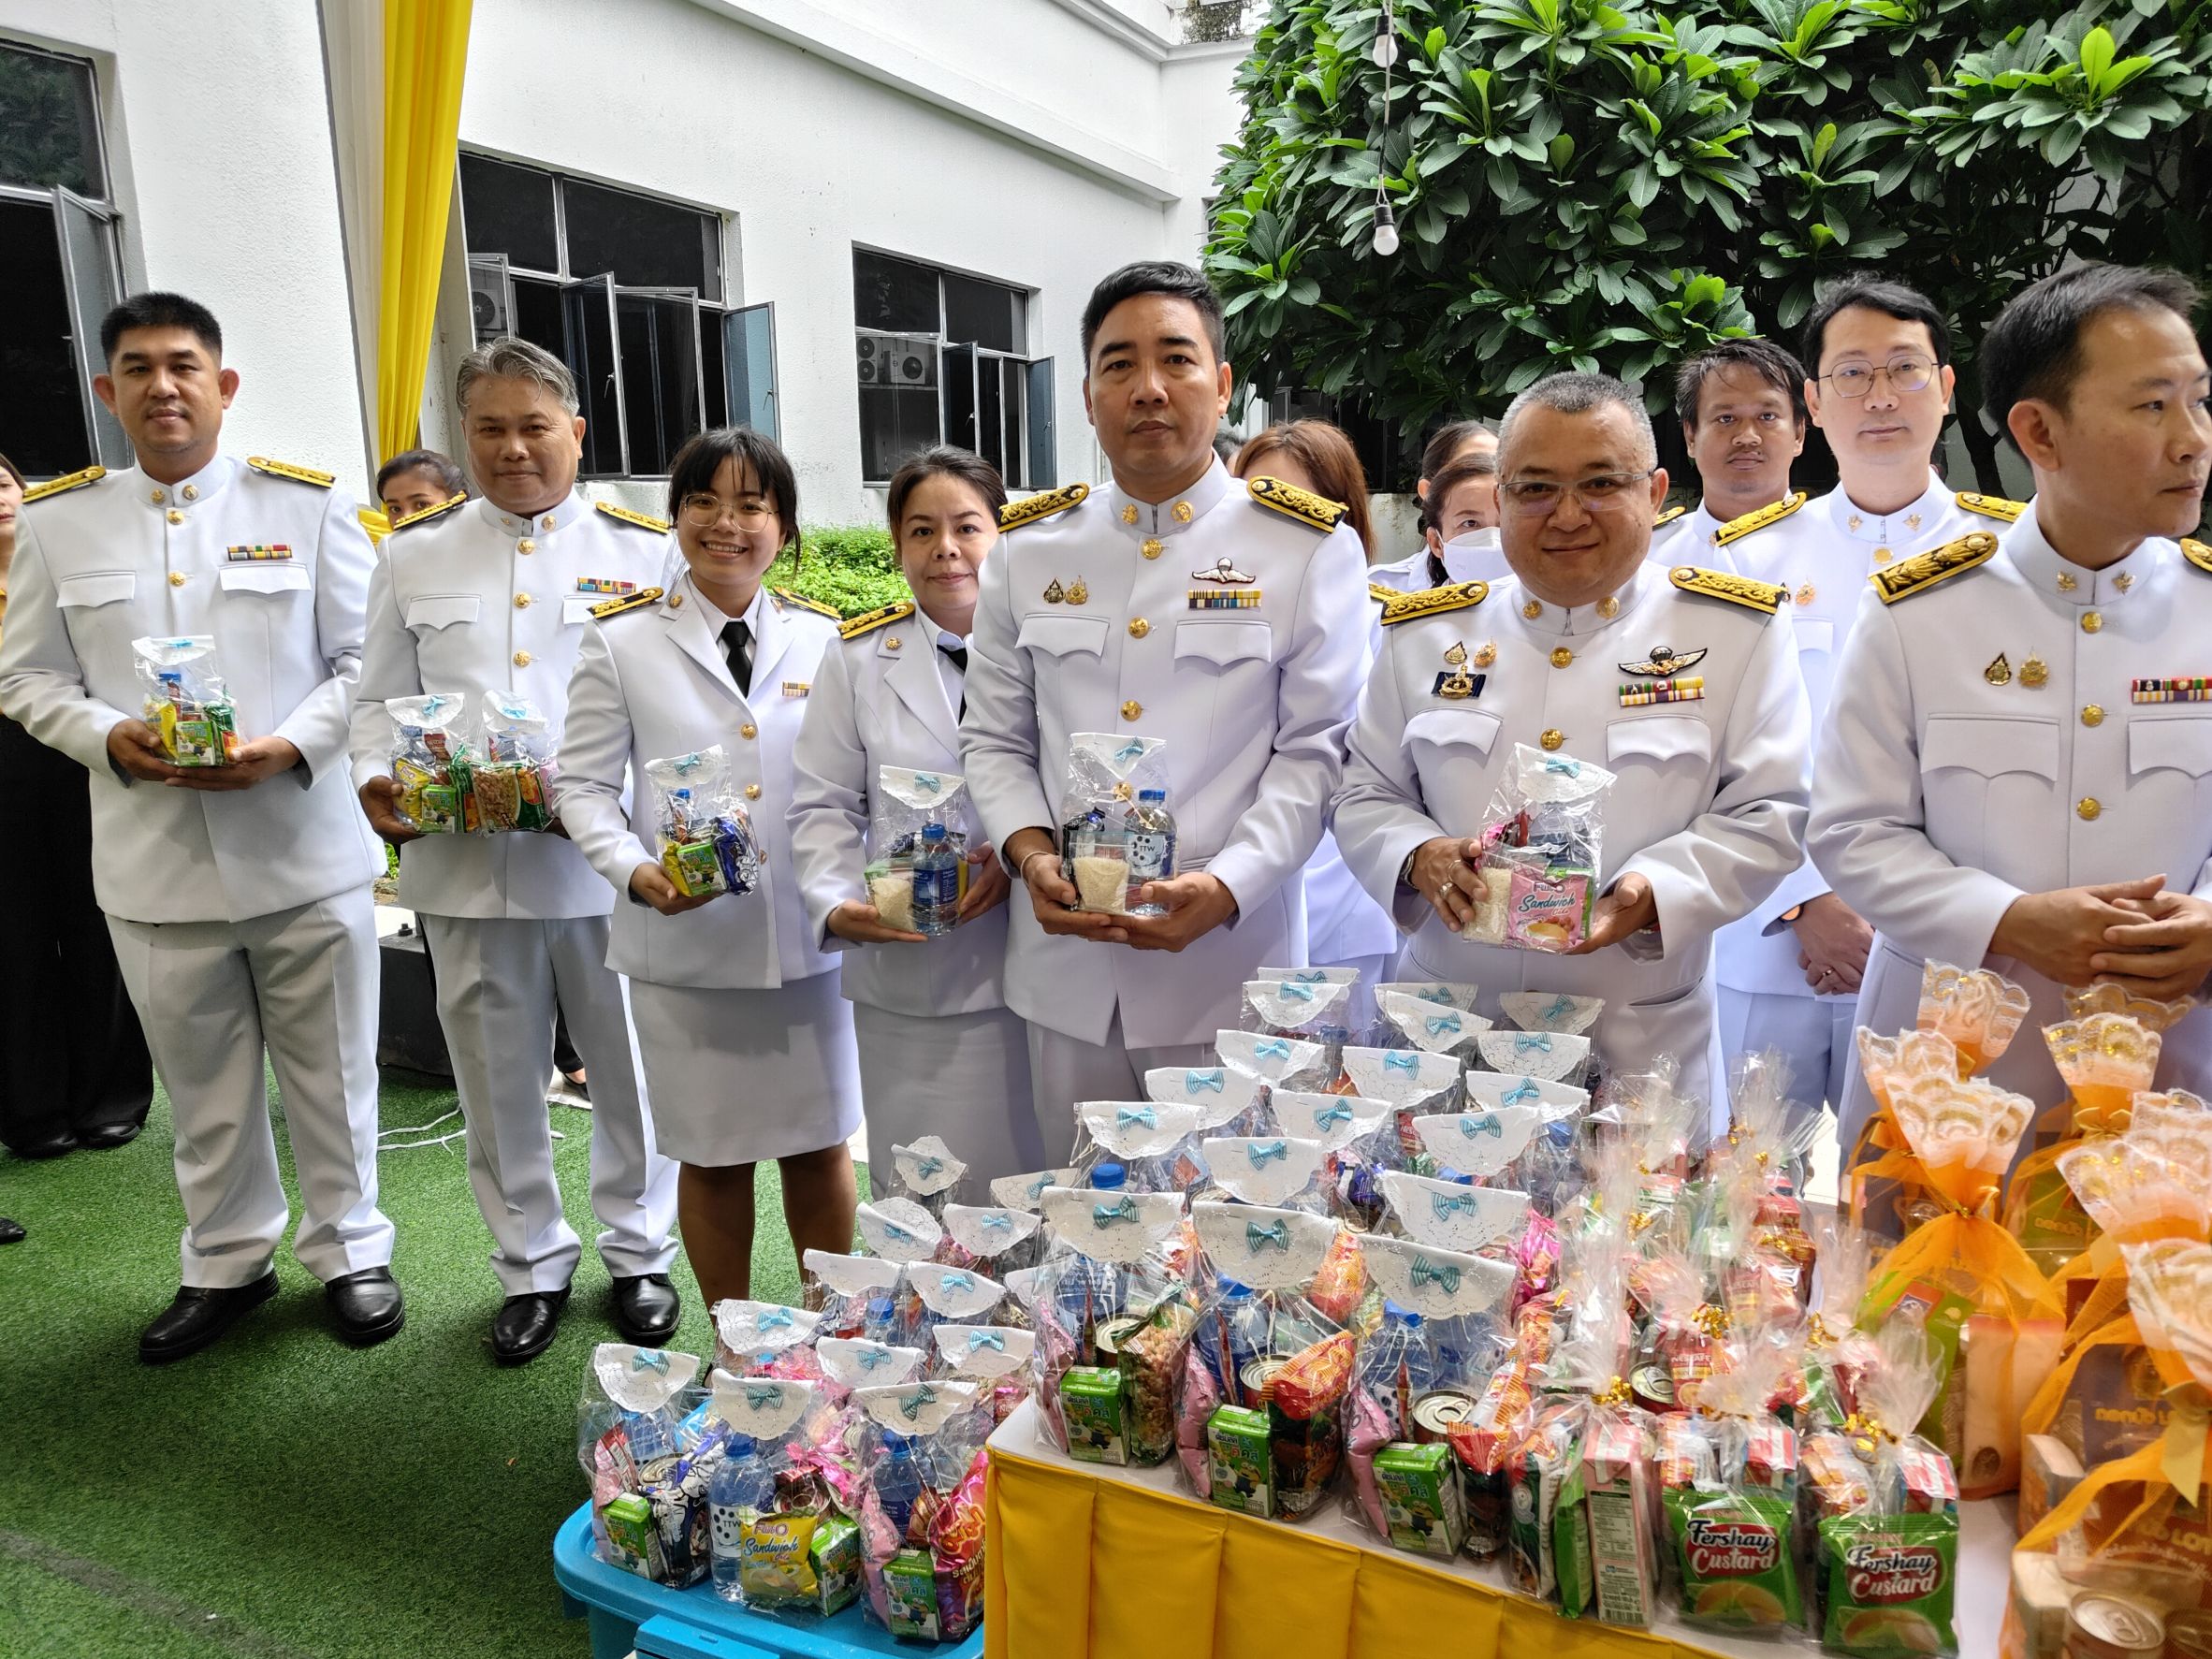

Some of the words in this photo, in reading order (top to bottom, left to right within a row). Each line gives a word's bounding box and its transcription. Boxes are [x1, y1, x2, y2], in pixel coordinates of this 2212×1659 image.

[1519, 892, 1576, 912] Sandwich
[744, 1535, 800, 1557] Sandwich
[1686, 1519, 1776, 1550] Fershay
[1692, 1548, 1776, 1575] Custard
[1847, 1544, 1937, 1573] Fershay
[1851, 1570, 1936, 1599] Custard
